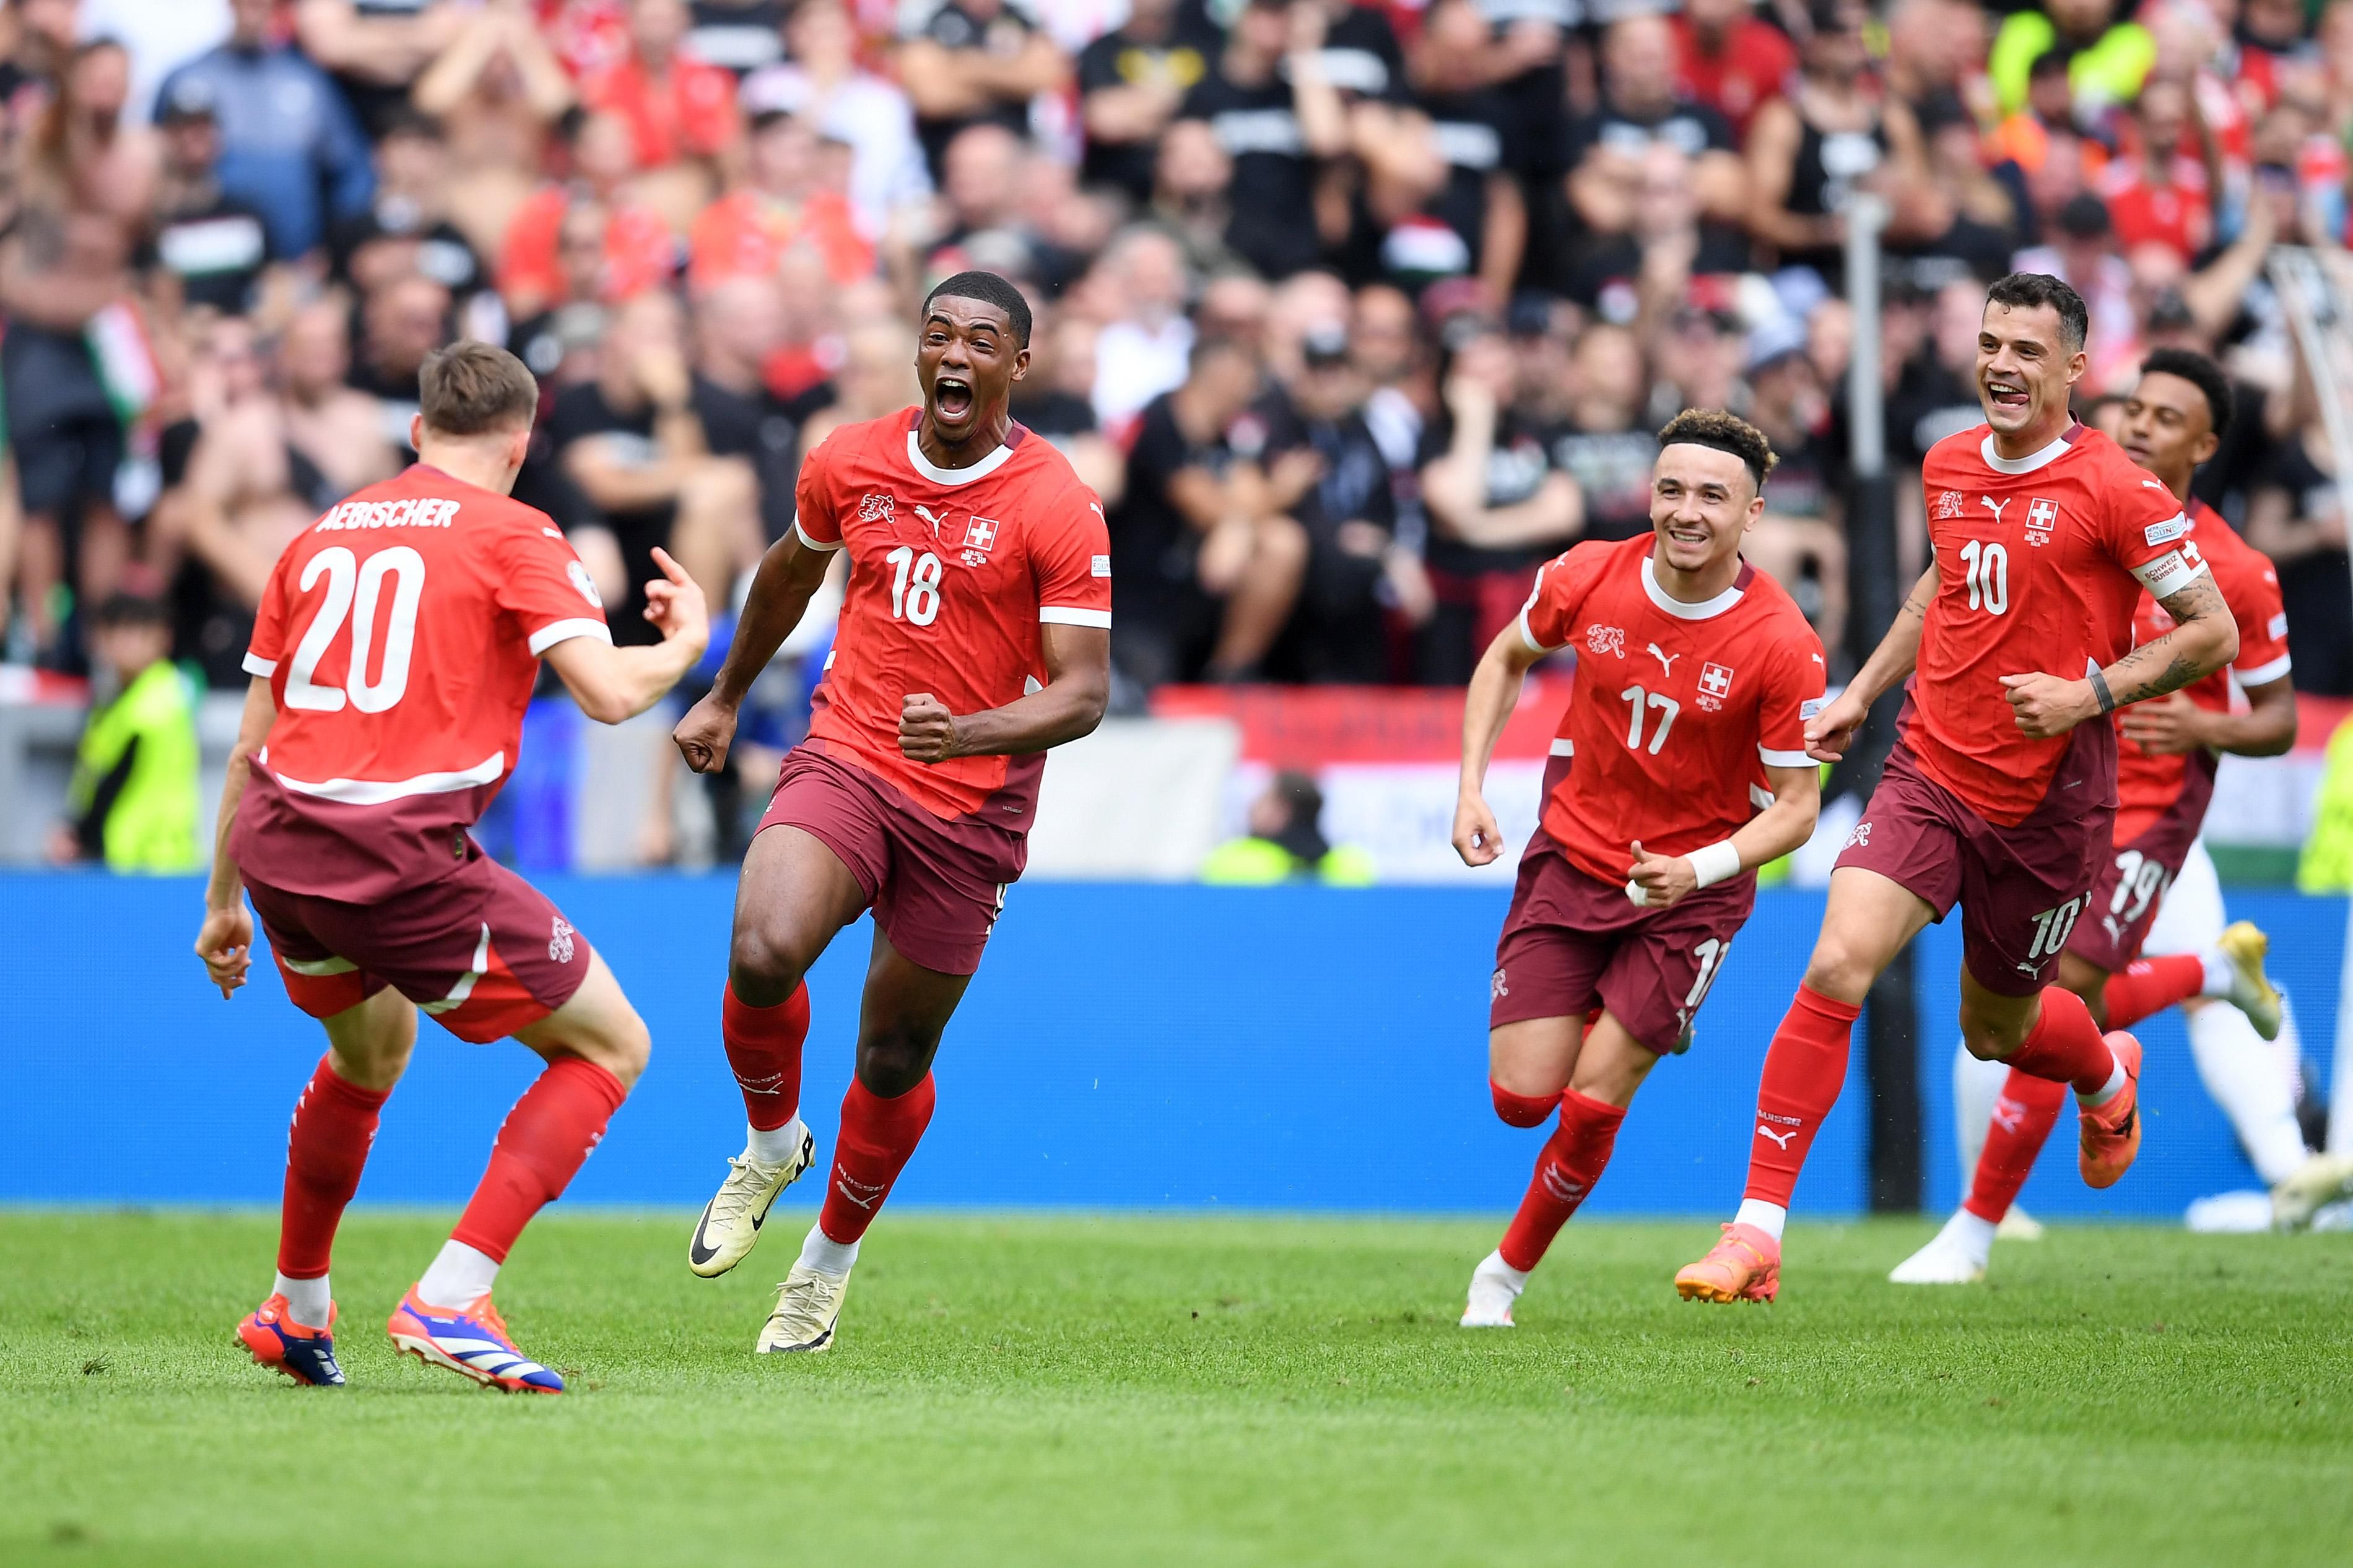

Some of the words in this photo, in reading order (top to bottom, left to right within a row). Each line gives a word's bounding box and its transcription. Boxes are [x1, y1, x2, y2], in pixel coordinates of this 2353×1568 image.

[315, 498, 461, 533] AEBISCHER
[886, 546, 942, 626] 18
[1960, 539, 2009, 615] 10
[2144, 555, 2178, 579] SCHWEIZ
[2152, 563, 2179, 583] SUISSE
[283, 545, 425, 713] 20
[1621, 685, 1680, 755] 17
[2110, 849, 2164, 922] 19
[2029, 897, 2081, 959] 10
